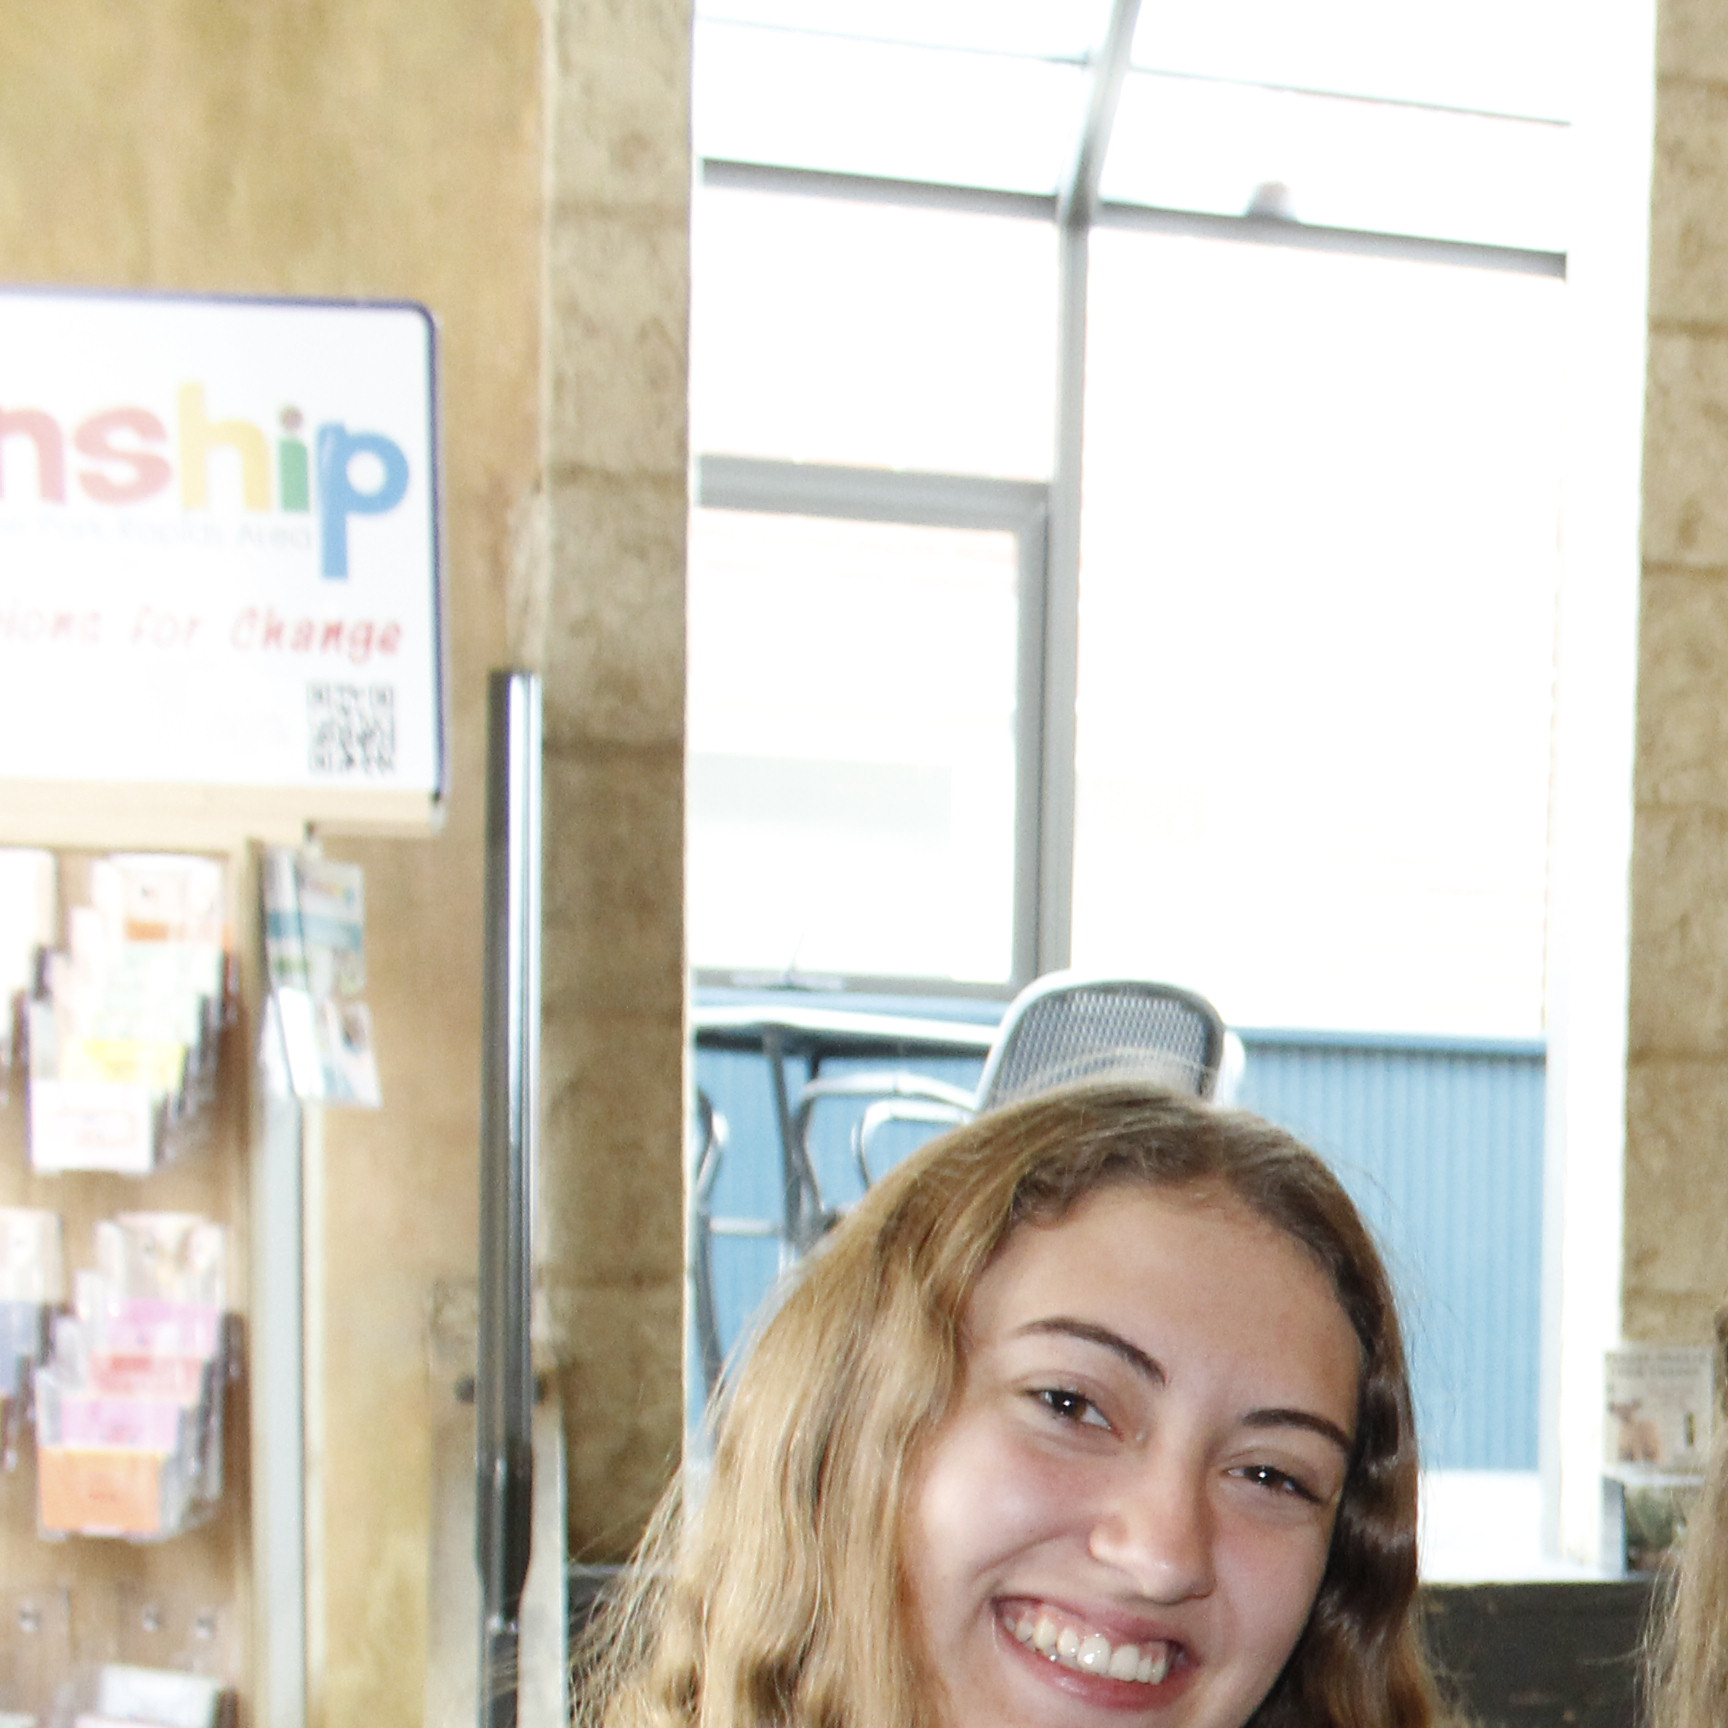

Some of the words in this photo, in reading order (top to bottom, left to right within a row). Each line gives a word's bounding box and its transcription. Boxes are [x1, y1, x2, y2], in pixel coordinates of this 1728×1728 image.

[0, 381, 411, 583] nship
[131, 602, 203, 649] for
[230, 604, 405, 665] Change
